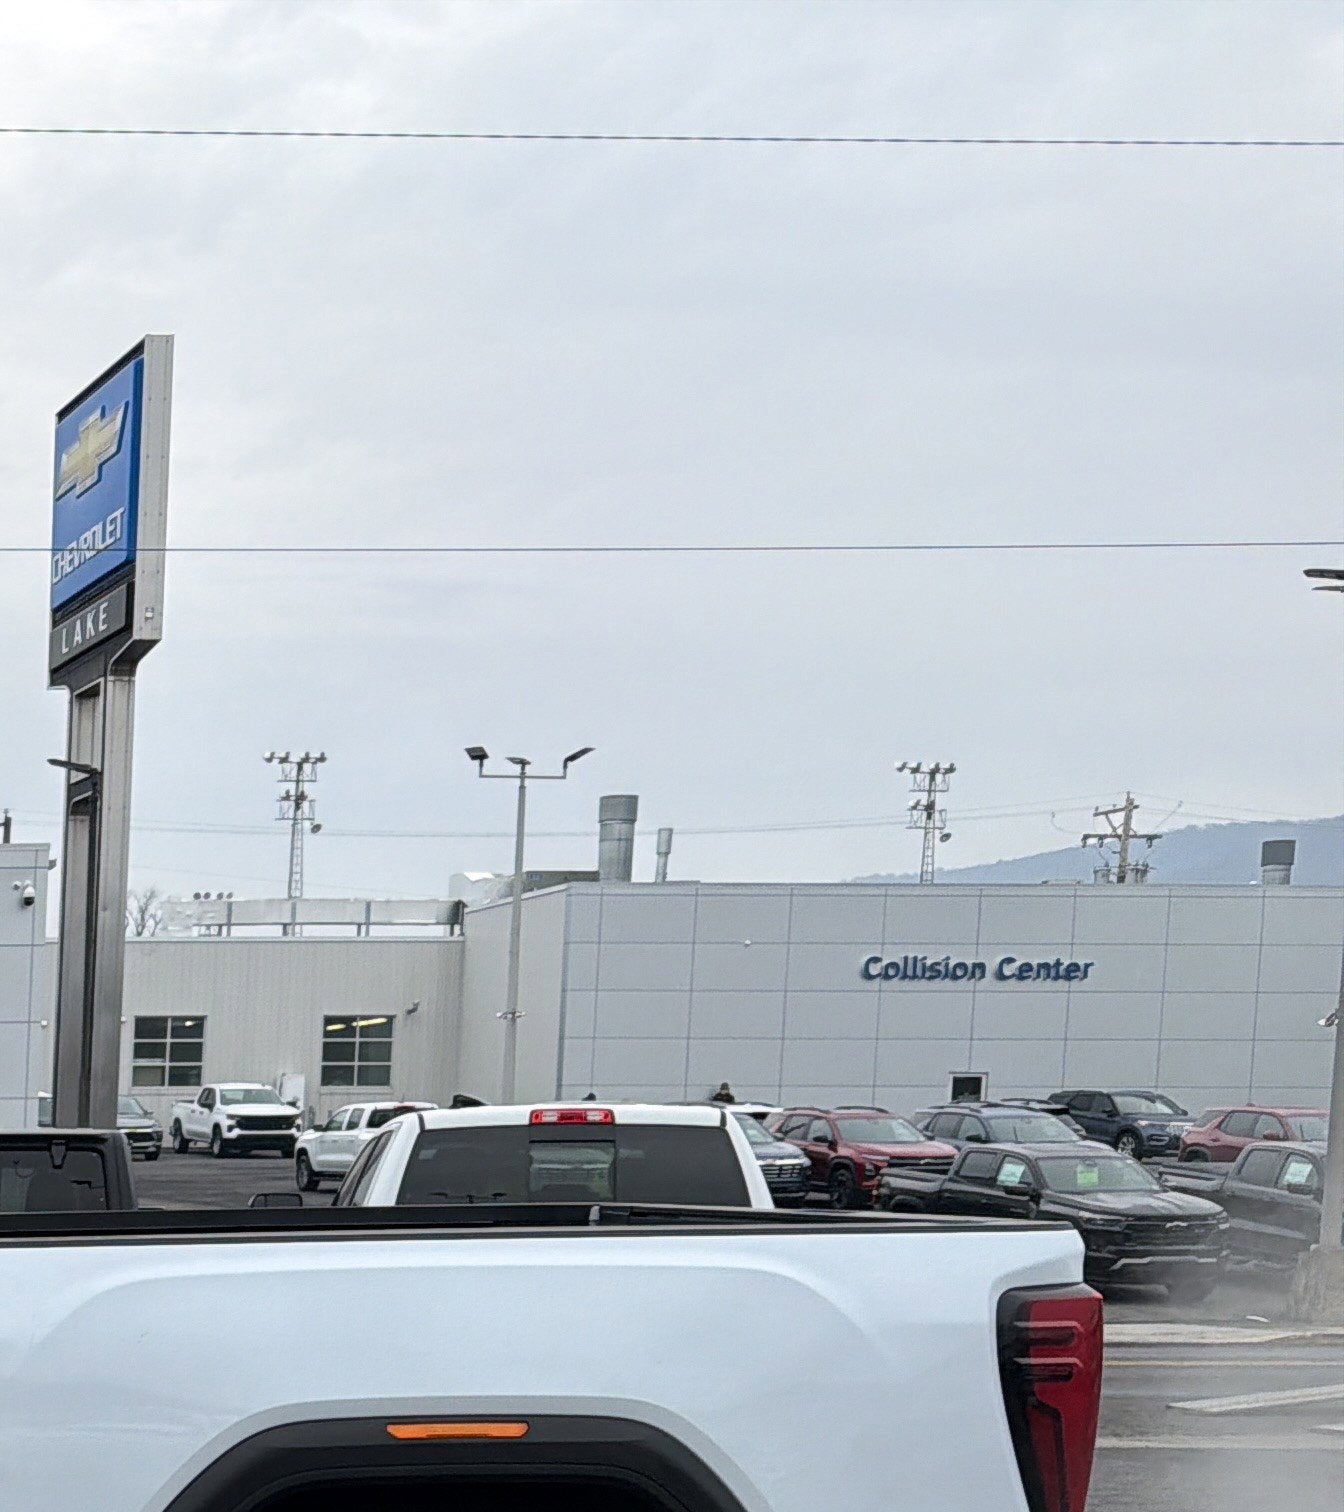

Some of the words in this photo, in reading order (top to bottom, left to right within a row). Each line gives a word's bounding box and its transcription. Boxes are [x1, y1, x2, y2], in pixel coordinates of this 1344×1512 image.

[51, 506, 126, 585] CHEVROLET
[60, 600, 109, 655] LAKE
[862, 954, 987, 982] Collision
[995, 956, 1095, 982] Center
